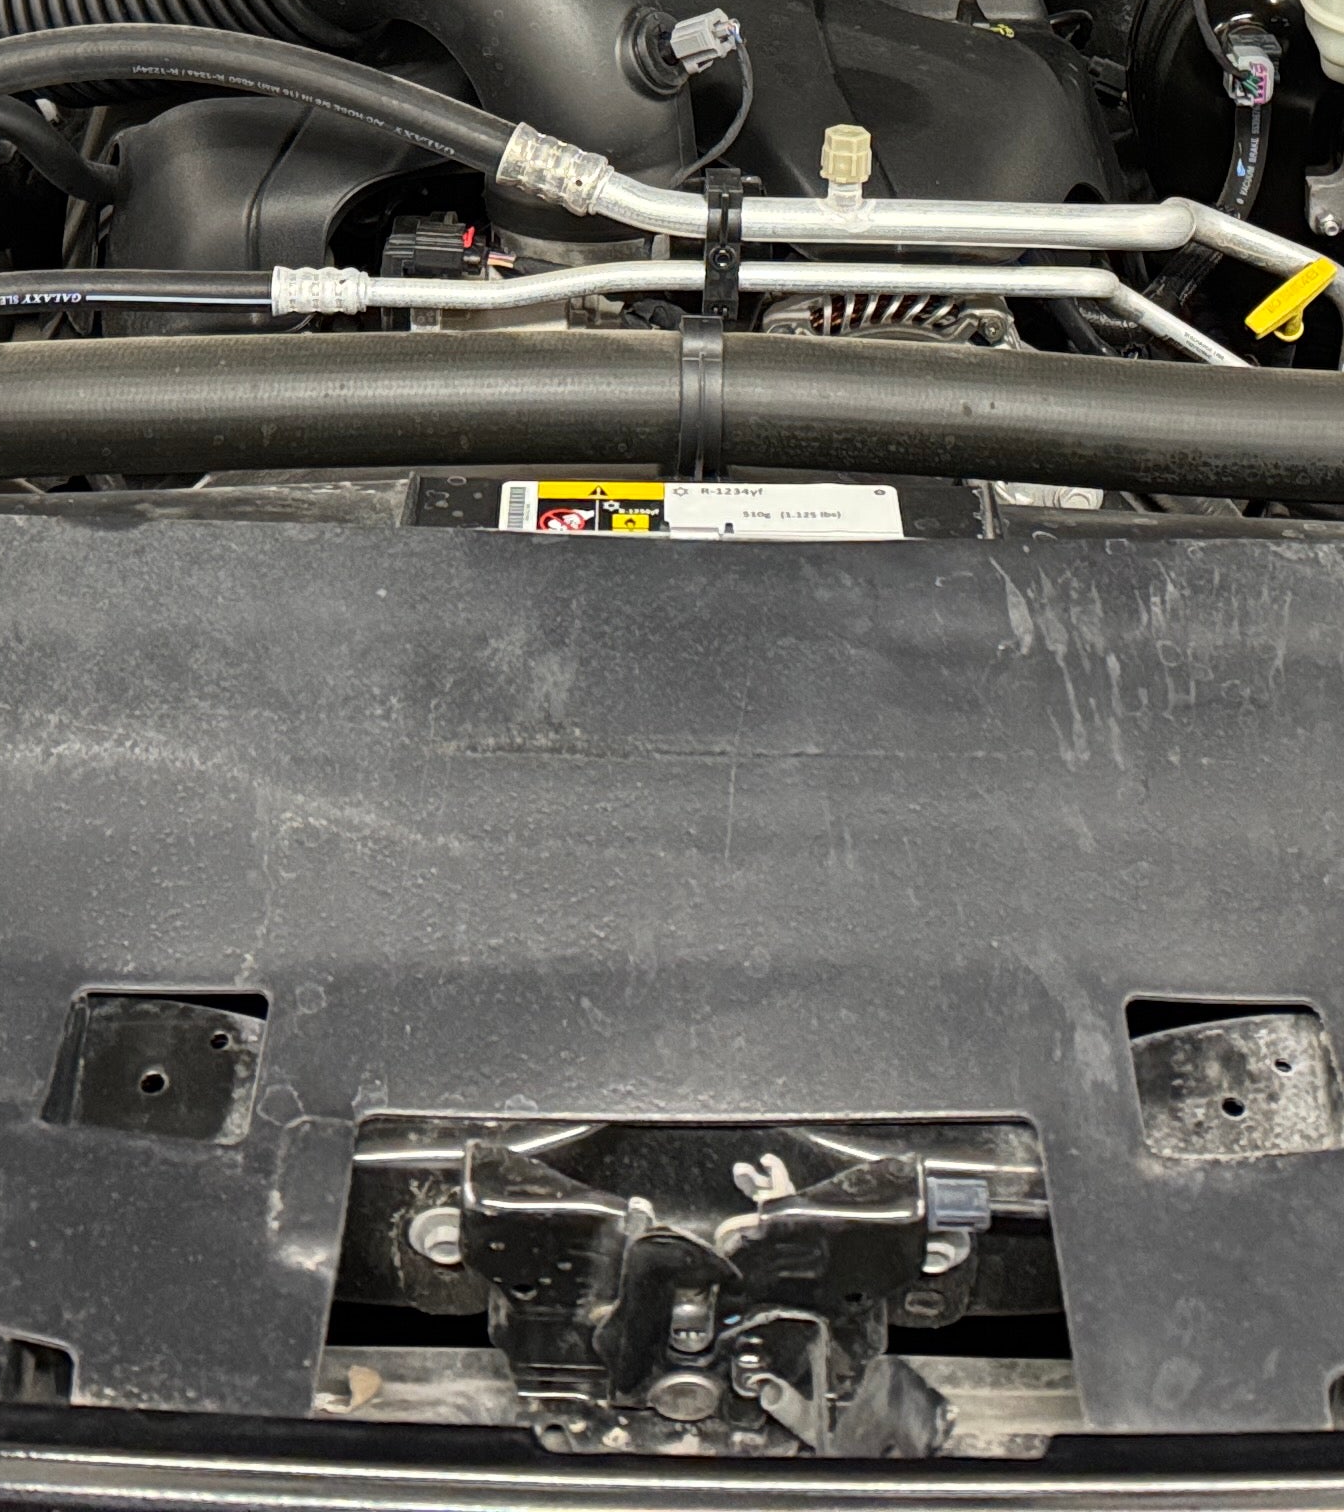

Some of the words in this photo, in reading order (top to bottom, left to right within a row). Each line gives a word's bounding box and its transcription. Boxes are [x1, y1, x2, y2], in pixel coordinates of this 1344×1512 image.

[393, 126, 455, 156] GALAXY
[0, 295, 21, 306] SLE
[22, 293, 81, 303] GALAXY
[700, 487, 764, 497] R-1234yf
